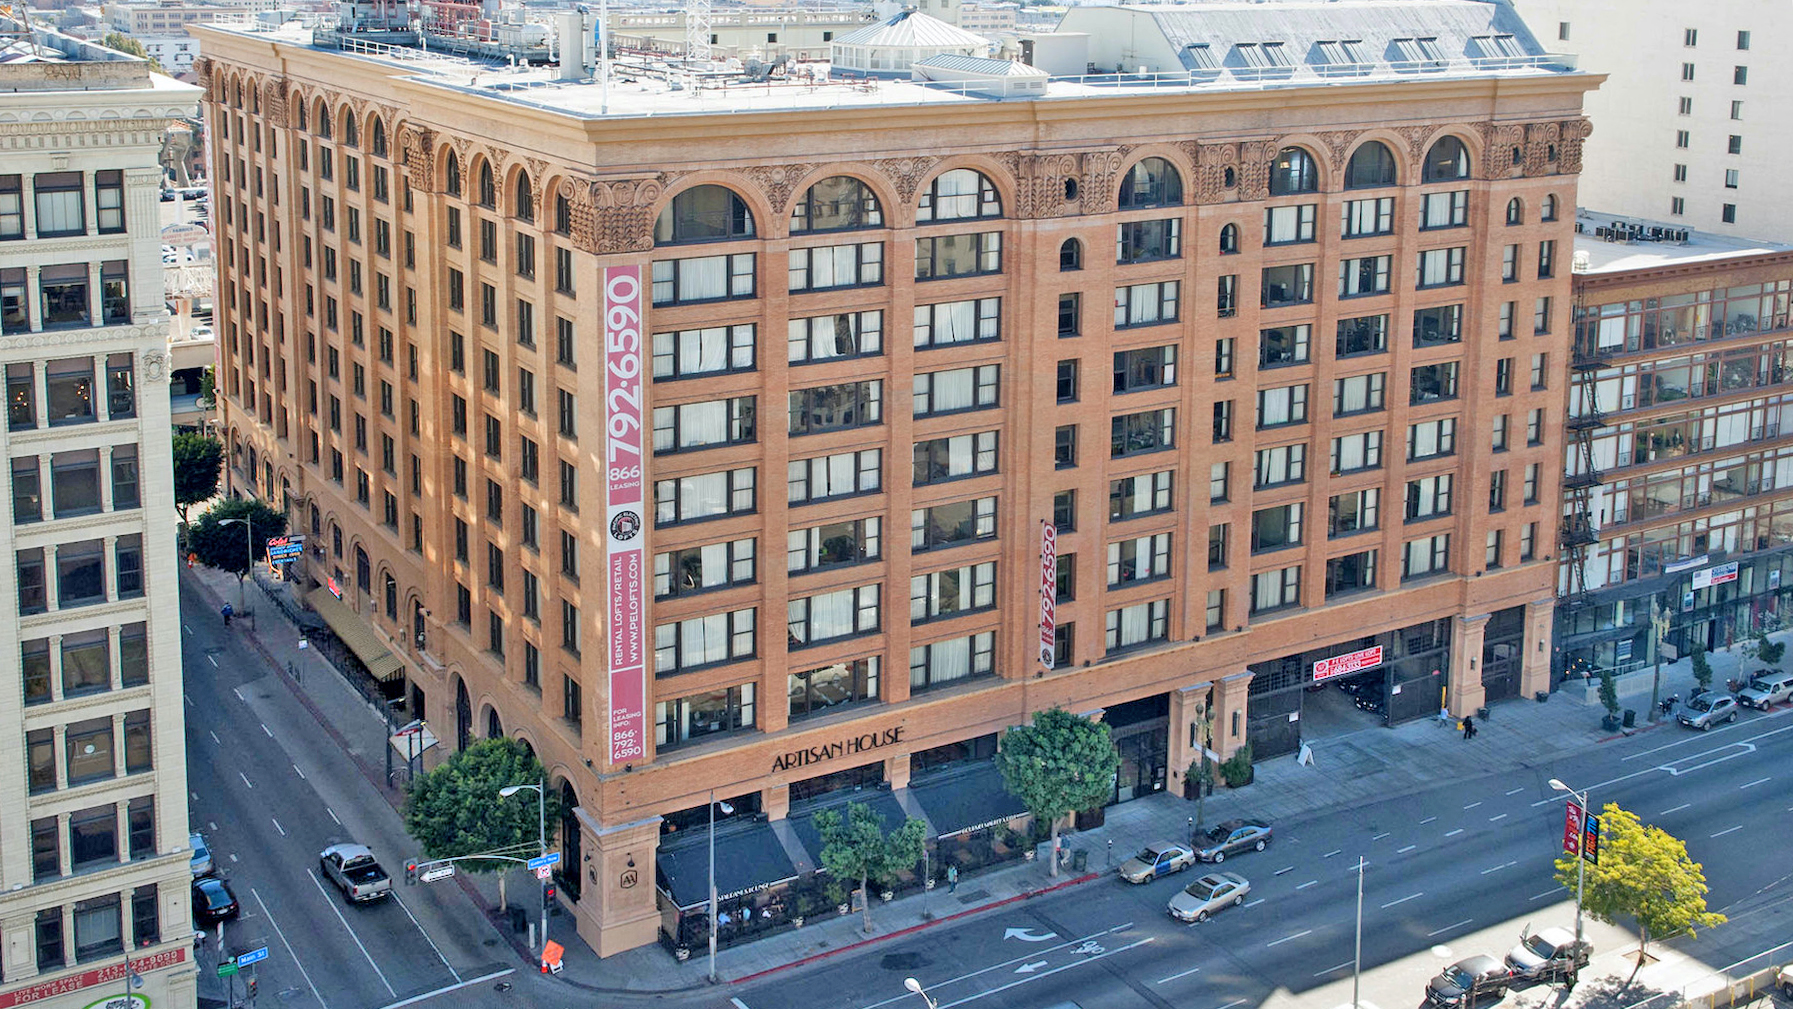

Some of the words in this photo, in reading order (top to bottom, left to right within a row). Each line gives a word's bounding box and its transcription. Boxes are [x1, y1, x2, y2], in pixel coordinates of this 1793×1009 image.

[609, 465, 640, 481] 866
[610, 481, 640, 491] LEASING
[613, 530, 638, 540] LOFTS
[614, 556, 622, 626] LOFTS/RETAIL
[629, 553, 638, 663] WWW.PELOFTS.COM
[615, 628, 623, 666] RENTAL
[613, 708, 627, 716] FOR
[613, 711, 641, 722] LEASING
[614, 746, 641, 759] 6590
[771, 741, 843, 773] ARTISAN
[847, 726, 905, 755] HOUSE
[240, 954, 257, 963] Main
[14, 989, 32, 997] LIVE
[34, 982, 56, 992] WORK
[59, 975, 84, 985] SPACE
[14, 992, 40, 1005] FOR
[44, 981, 83, 997] LEASE
